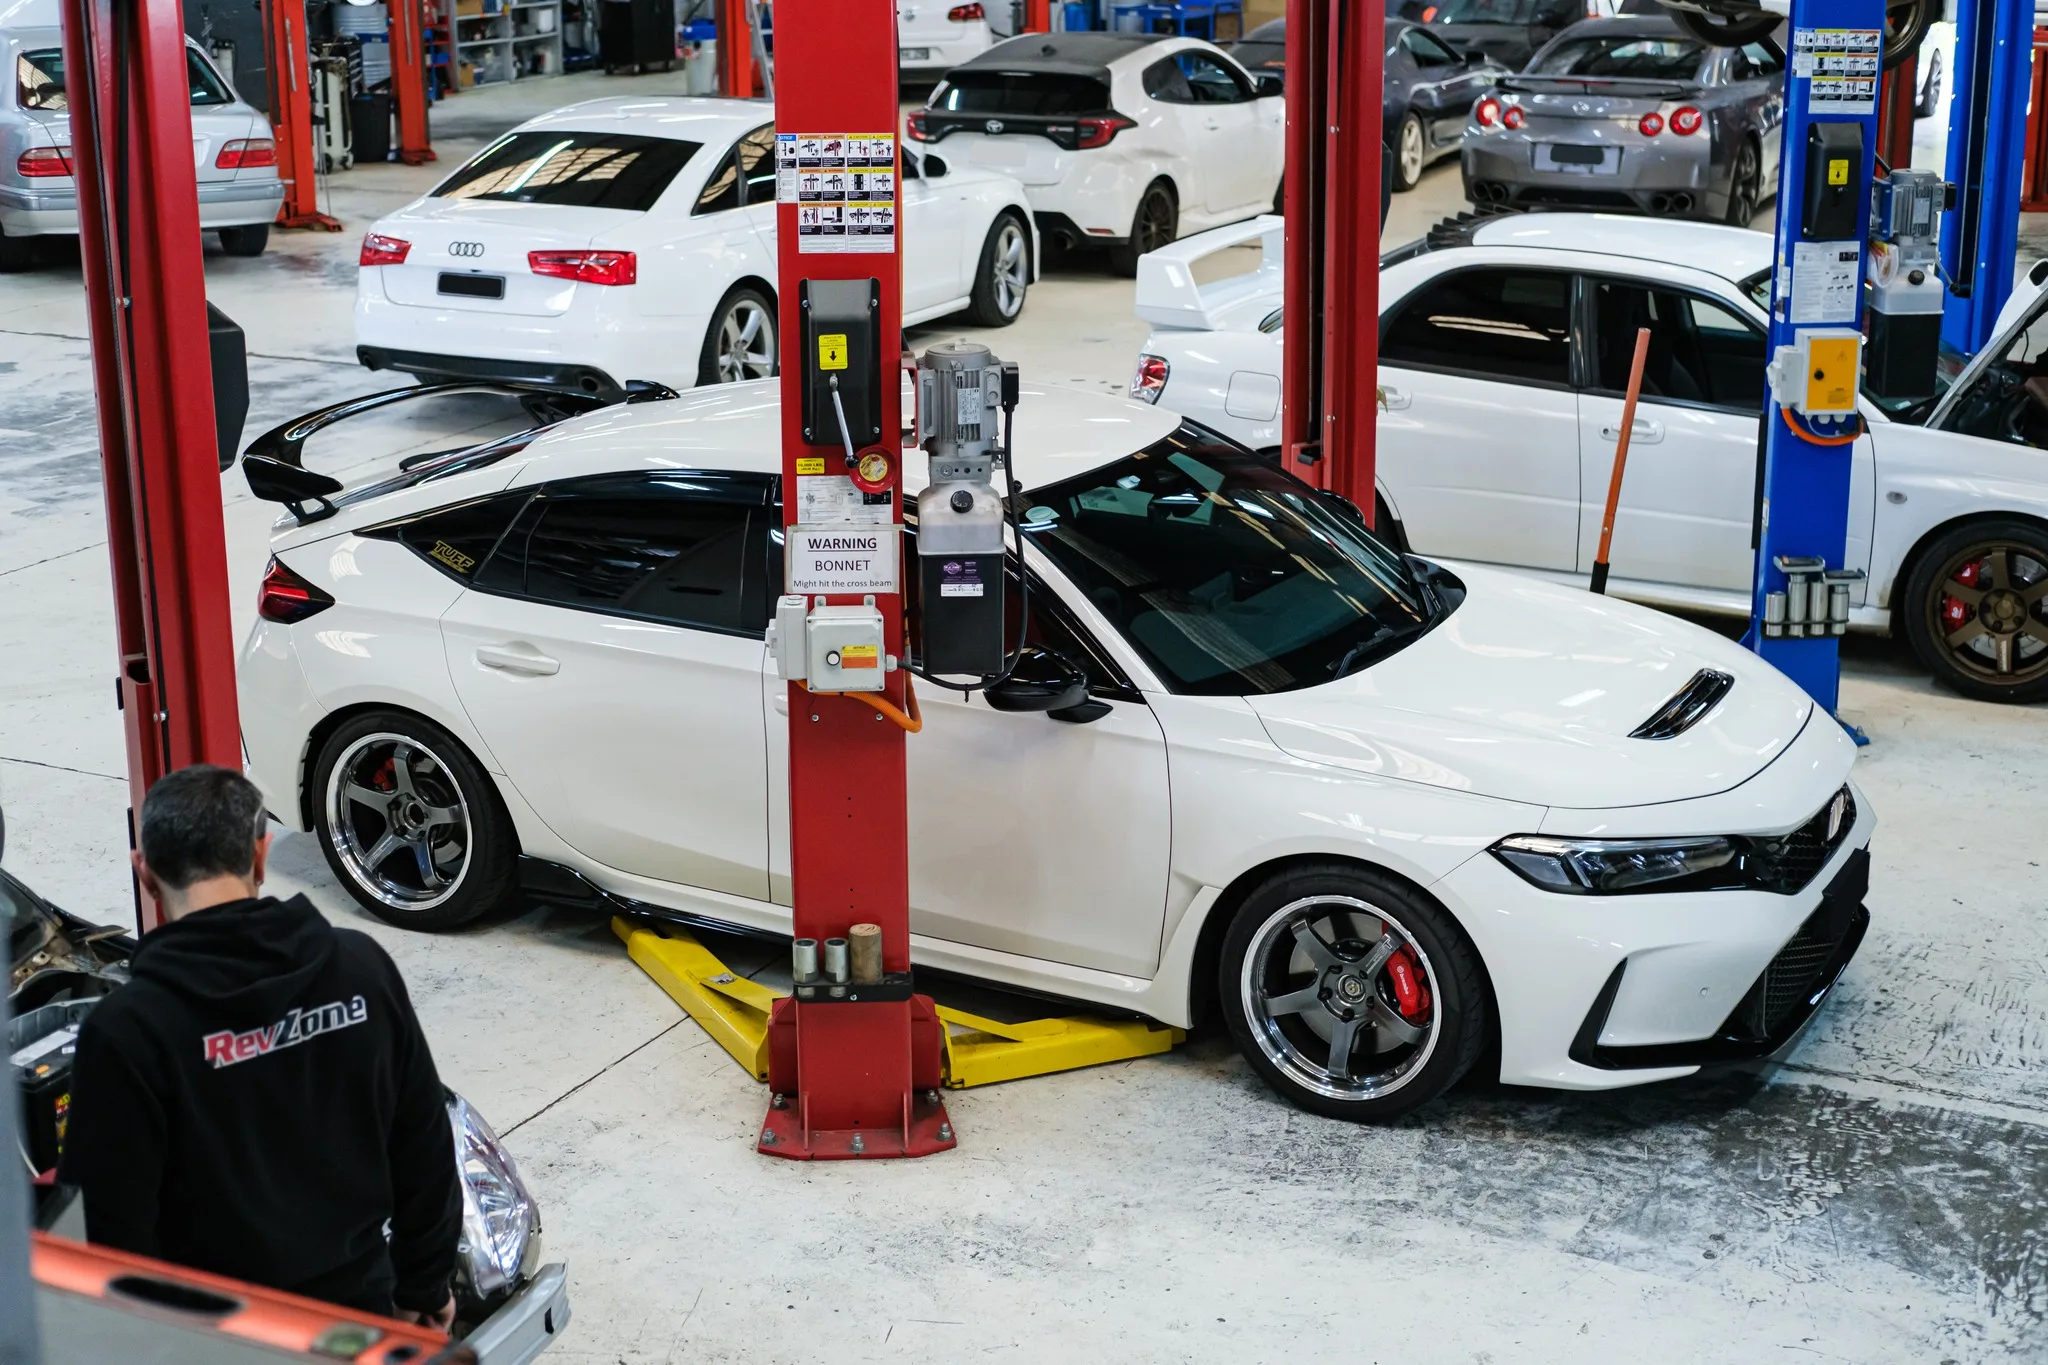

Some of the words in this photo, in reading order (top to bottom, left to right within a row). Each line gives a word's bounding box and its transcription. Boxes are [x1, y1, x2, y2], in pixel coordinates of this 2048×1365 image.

[808, 538, 877, 549] WARNING
[434, 540, 475, 568] TUFF
[815, 560, 871, 571] BONNET
[793, 580, 817, 589] Might
[202, 994, 368, 1069] RevZone
